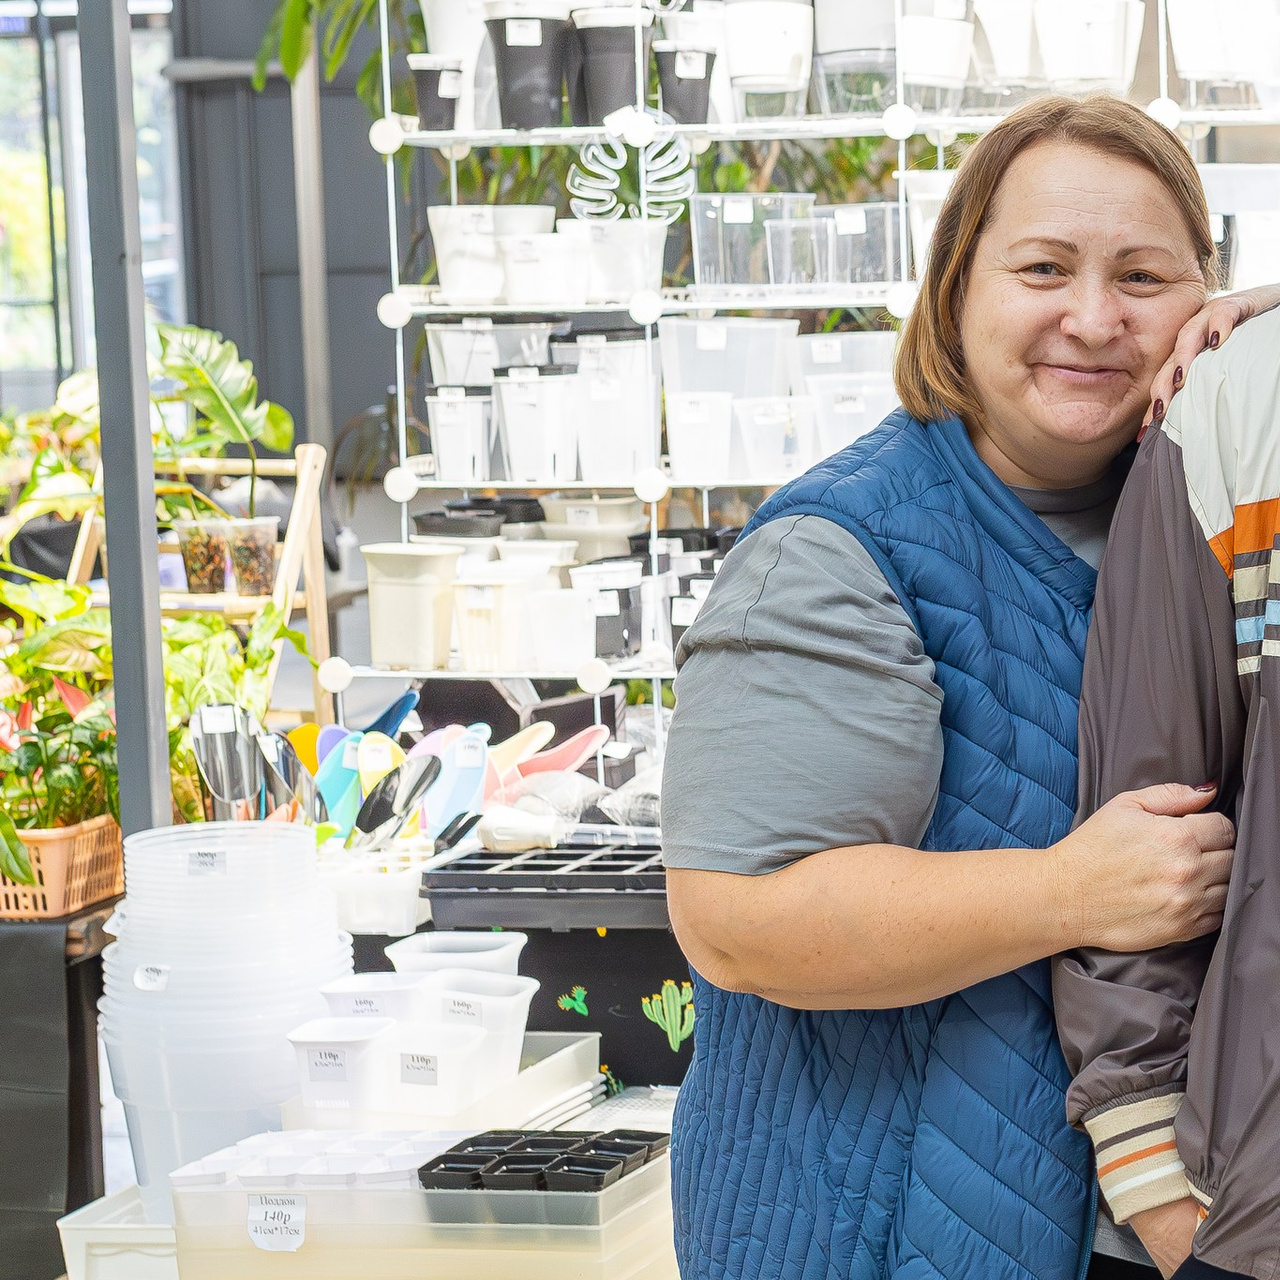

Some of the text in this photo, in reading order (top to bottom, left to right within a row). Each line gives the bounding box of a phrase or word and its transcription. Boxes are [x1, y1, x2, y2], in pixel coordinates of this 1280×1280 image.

[452, 1000, 472, 1010] 160р
[318, 1051, 339, 1061] 110р
[410, 1055, 431, 1065] 110р
[264, 1210, 291, 1225] 140р
